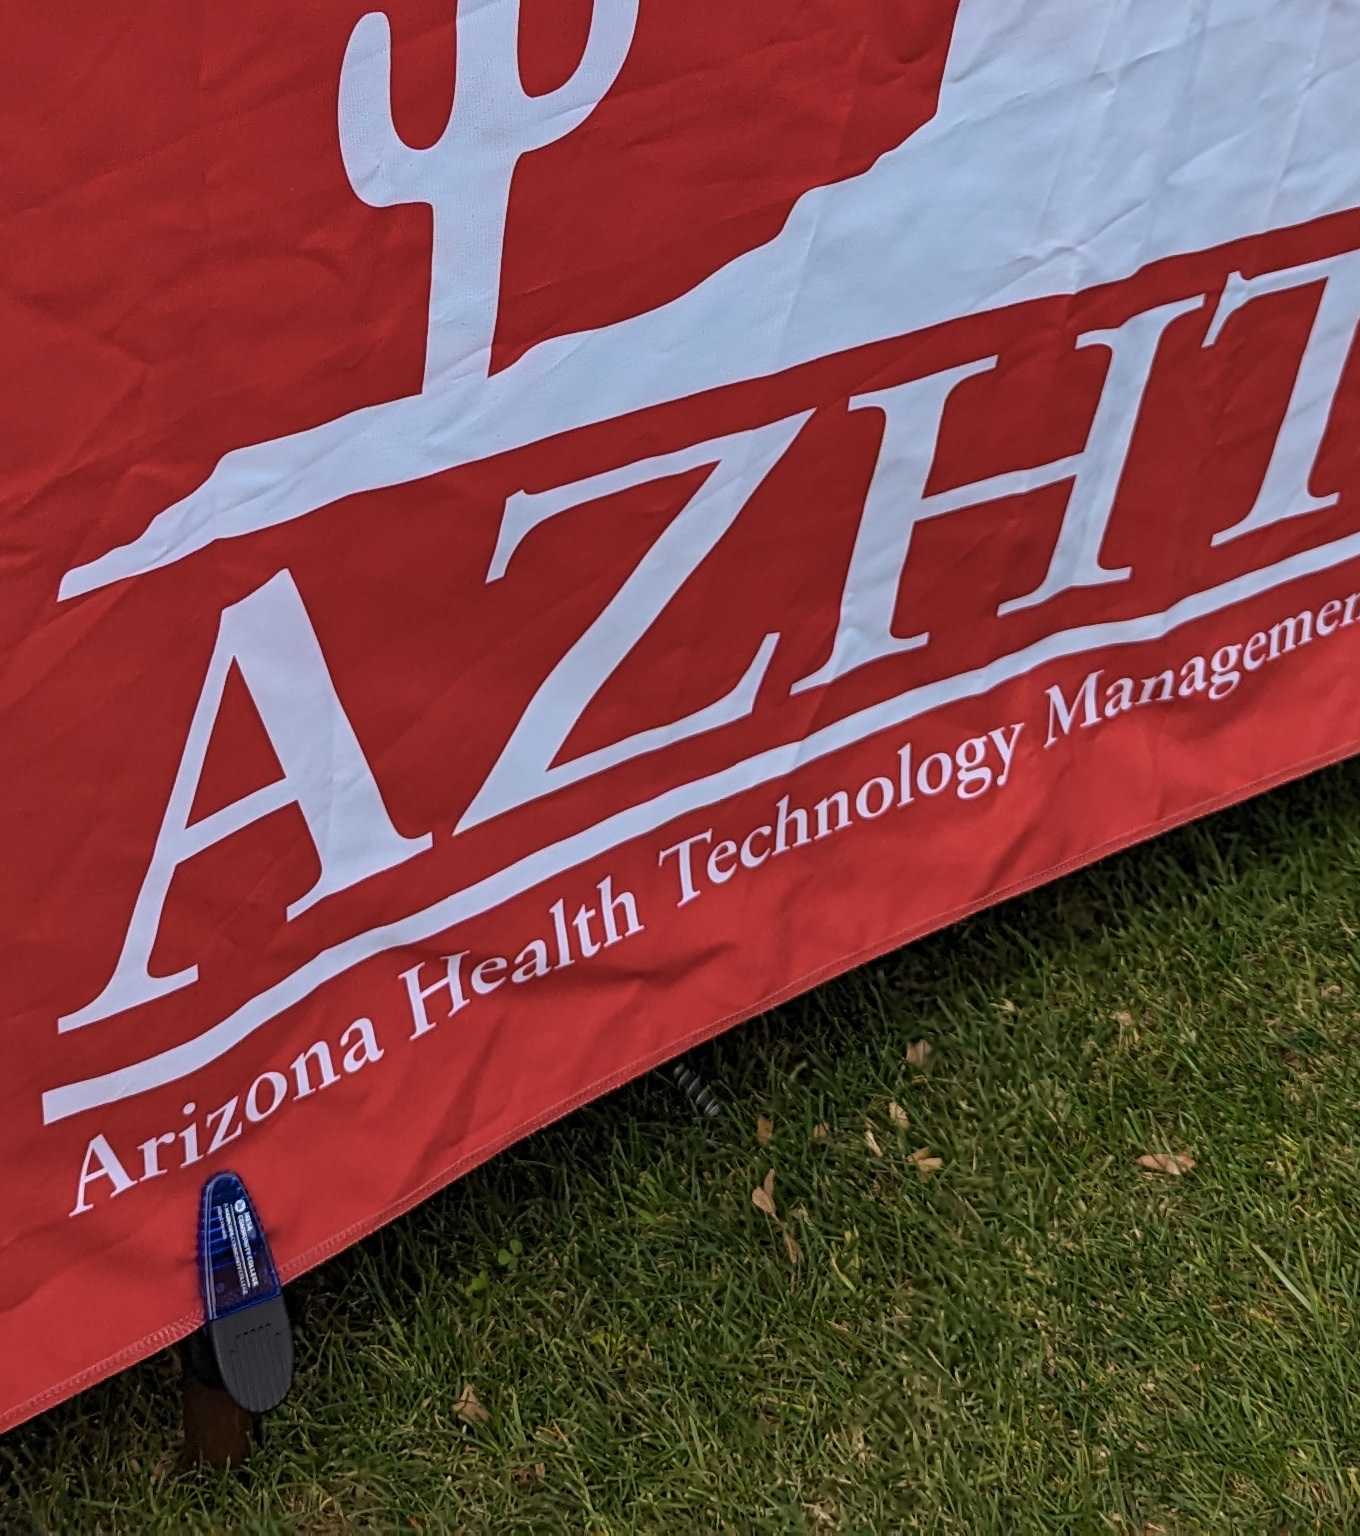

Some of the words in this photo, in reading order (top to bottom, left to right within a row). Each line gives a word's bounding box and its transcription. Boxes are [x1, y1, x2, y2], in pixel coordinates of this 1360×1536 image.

[69, 1018, 384, 1216] Arizona
[399, 876, 644, 1040] Health
[659, 723, 1024, 907] Technology
[245, 1256, 259, 1287] COLLEGE
